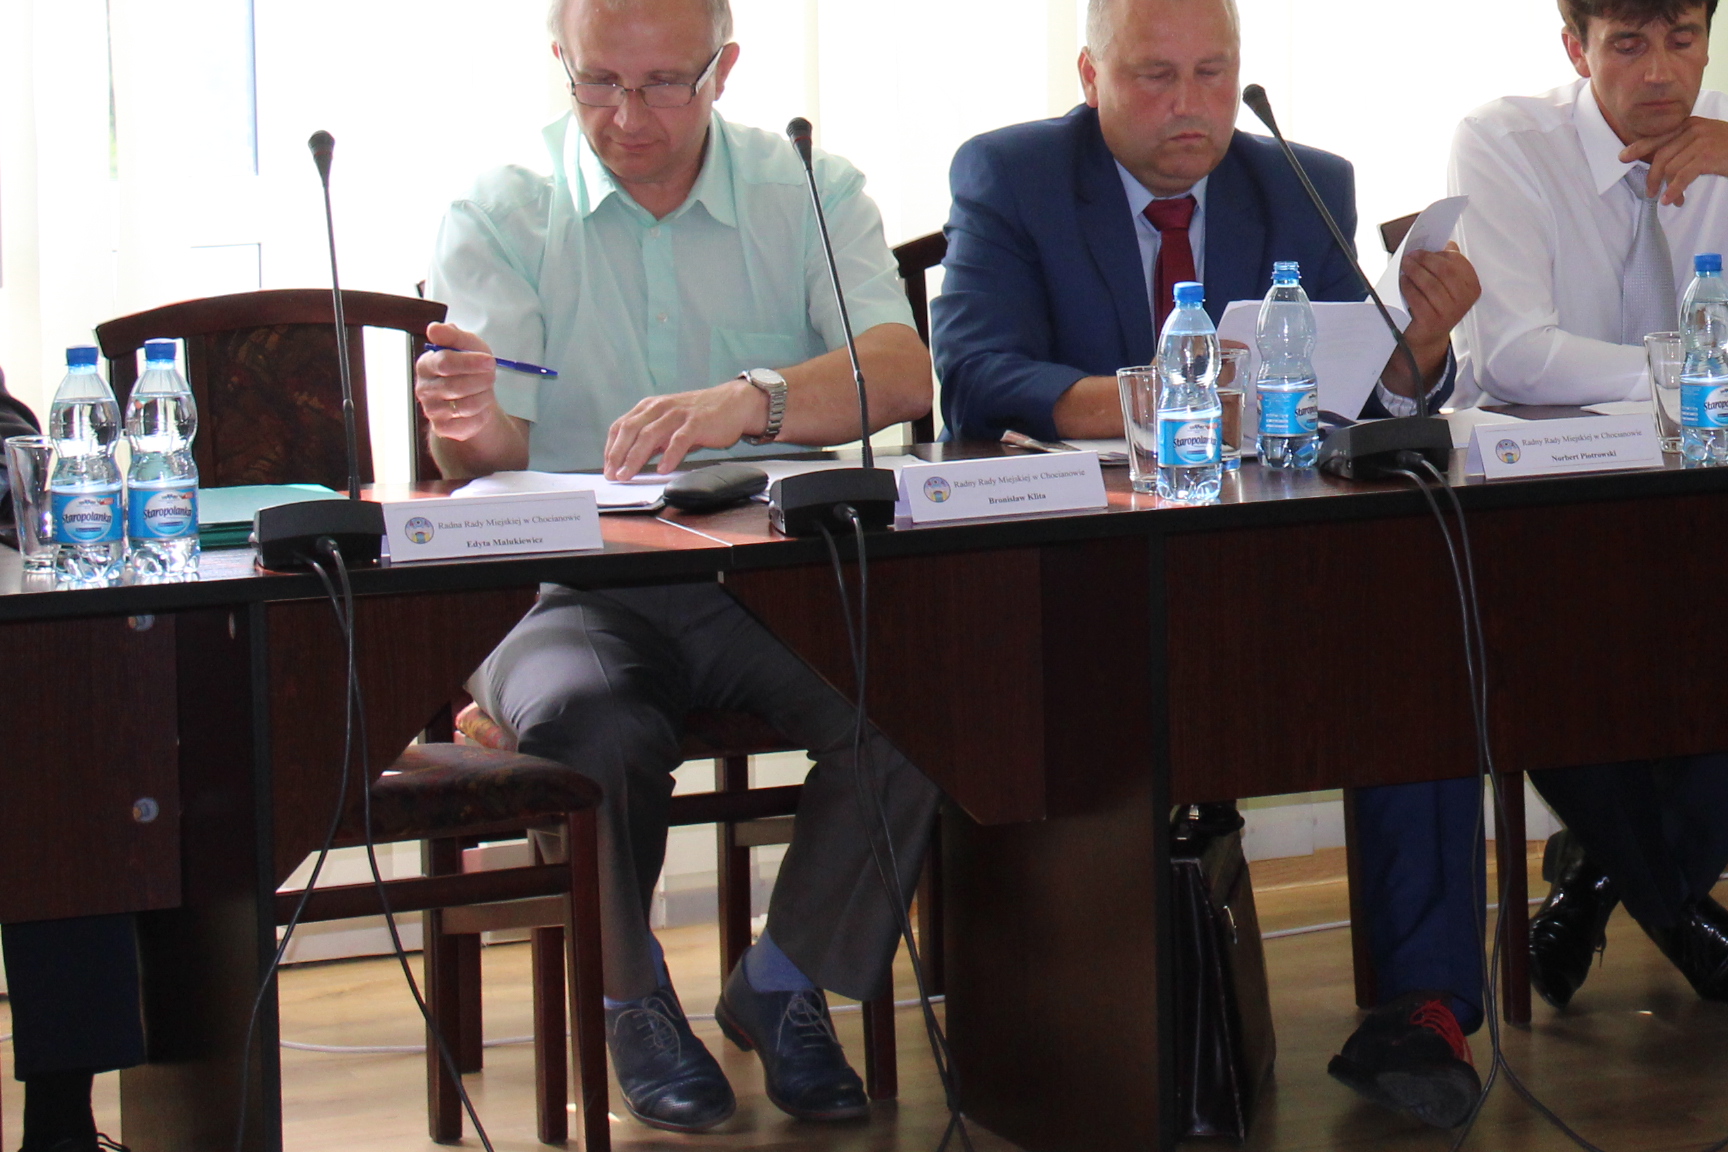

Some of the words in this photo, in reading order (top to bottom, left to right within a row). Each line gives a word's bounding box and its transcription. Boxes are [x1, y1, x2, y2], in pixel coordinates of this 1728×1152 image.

[1522, 438, 1543, 447] Radny
[1544, 436, 1561, 446] Rady
[1562, 434, 1593, 444] Miejskiej
[1600, 428, 1642, 439] Chocianowie
[1552, 454, 1579, 463] Norbert
[1580, 450, 1617, 460] Piotrowski
[954, 480, 976, 489] Radny
[978, 478, 996, 488] Rady
[998, 476, 1032, 485] Miejskiej
[1040, 469, 1086, 480] Chocianowie
[62, 511, 112, 524] Staropolanka
[143, 506, 192, 520] Staropolanka
[438, 521, 462, 530] Radna
[464, 520, 484, 530] Rady
[486, 516, 522, 527] Miejskiej
[532, 514, 581, 524] Chocianowie
[466, 540, 492, 549] Edyta
